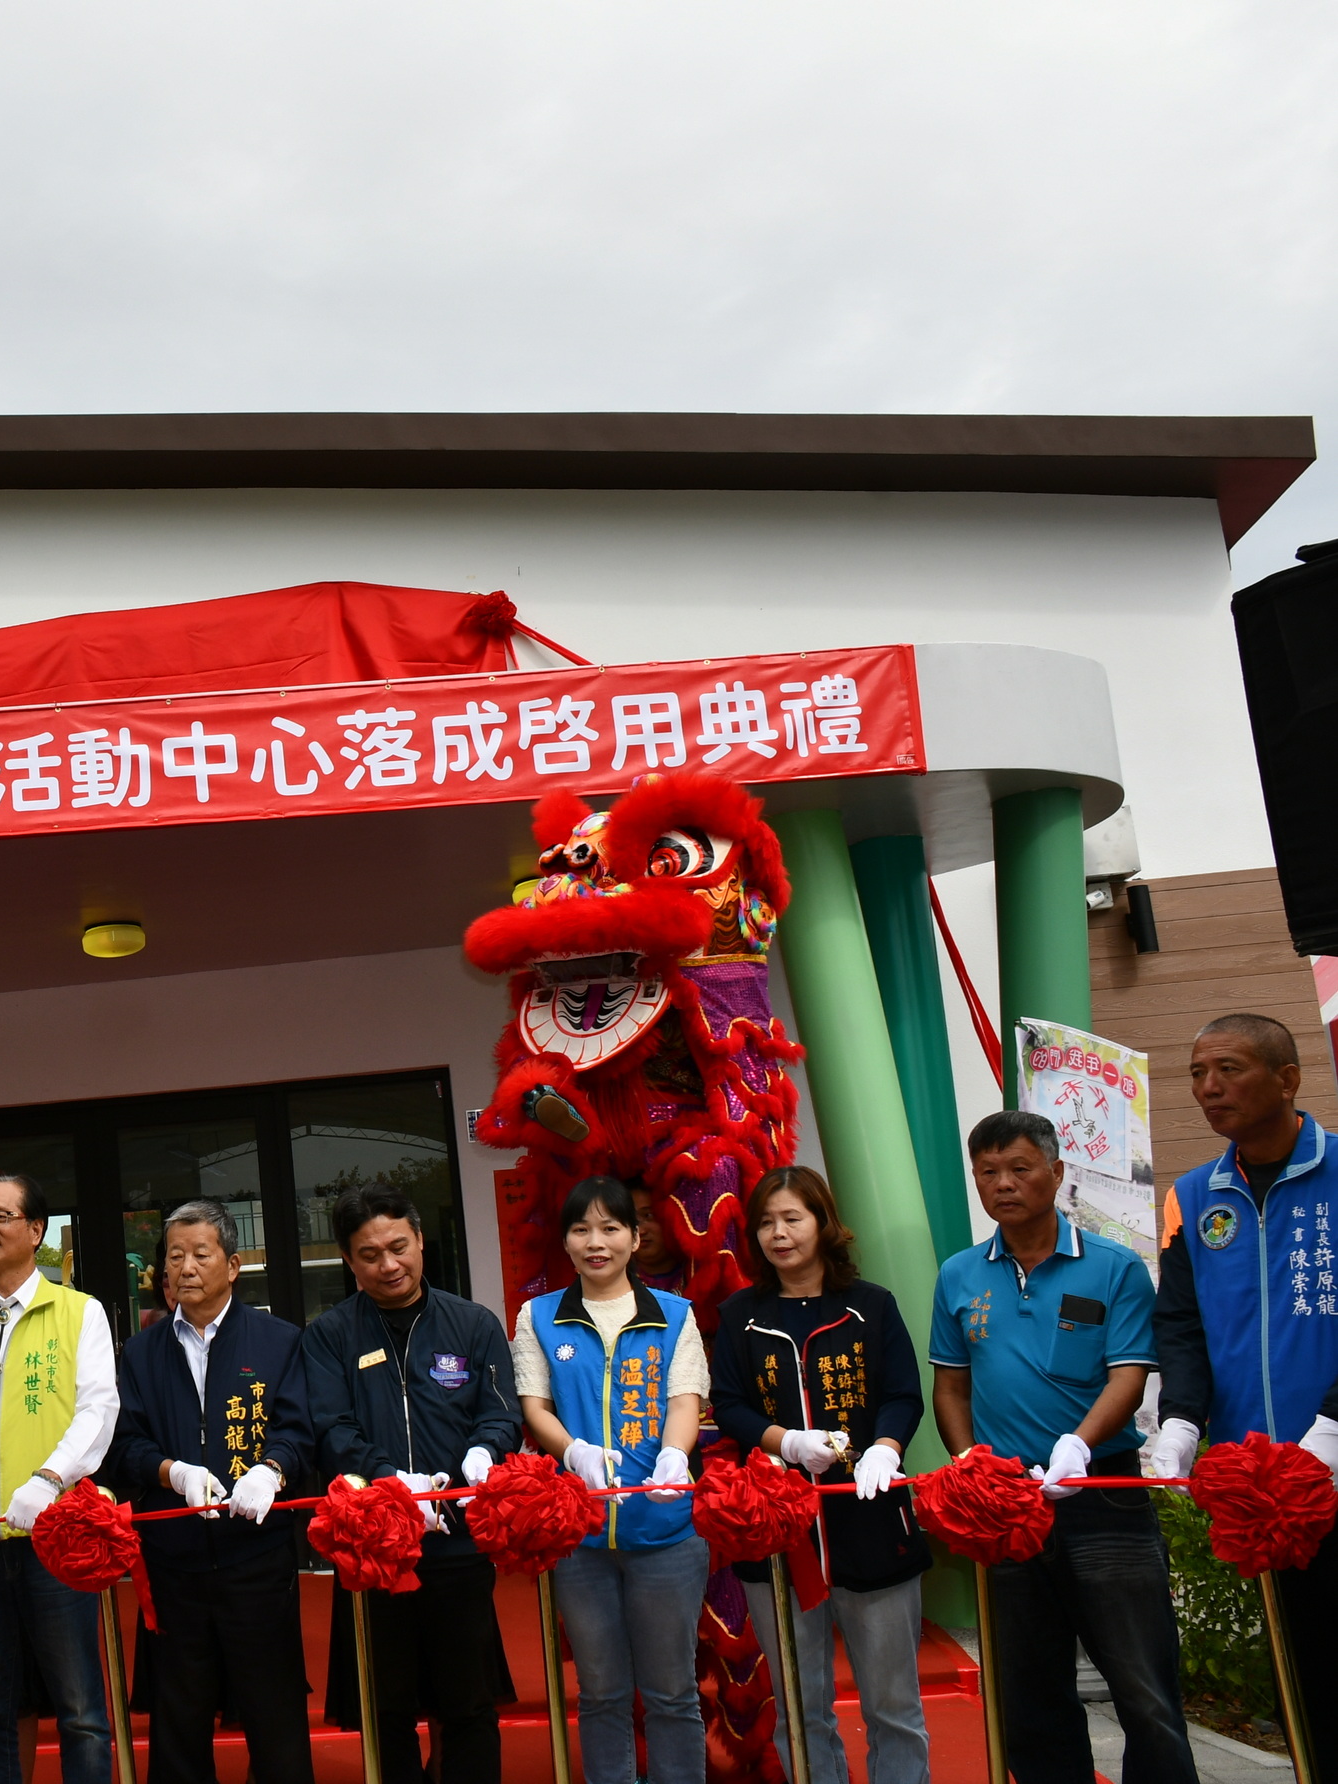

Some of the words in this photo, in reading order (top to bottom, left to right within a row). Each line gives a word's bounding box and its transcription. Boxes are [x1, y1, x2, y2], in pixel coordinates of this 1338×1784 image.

[24, 1351, 43, 1415] 林世賢
[45, 1338, 58, 1393] 彰化市長
[818, 1355, 839, 1410] 張東正
